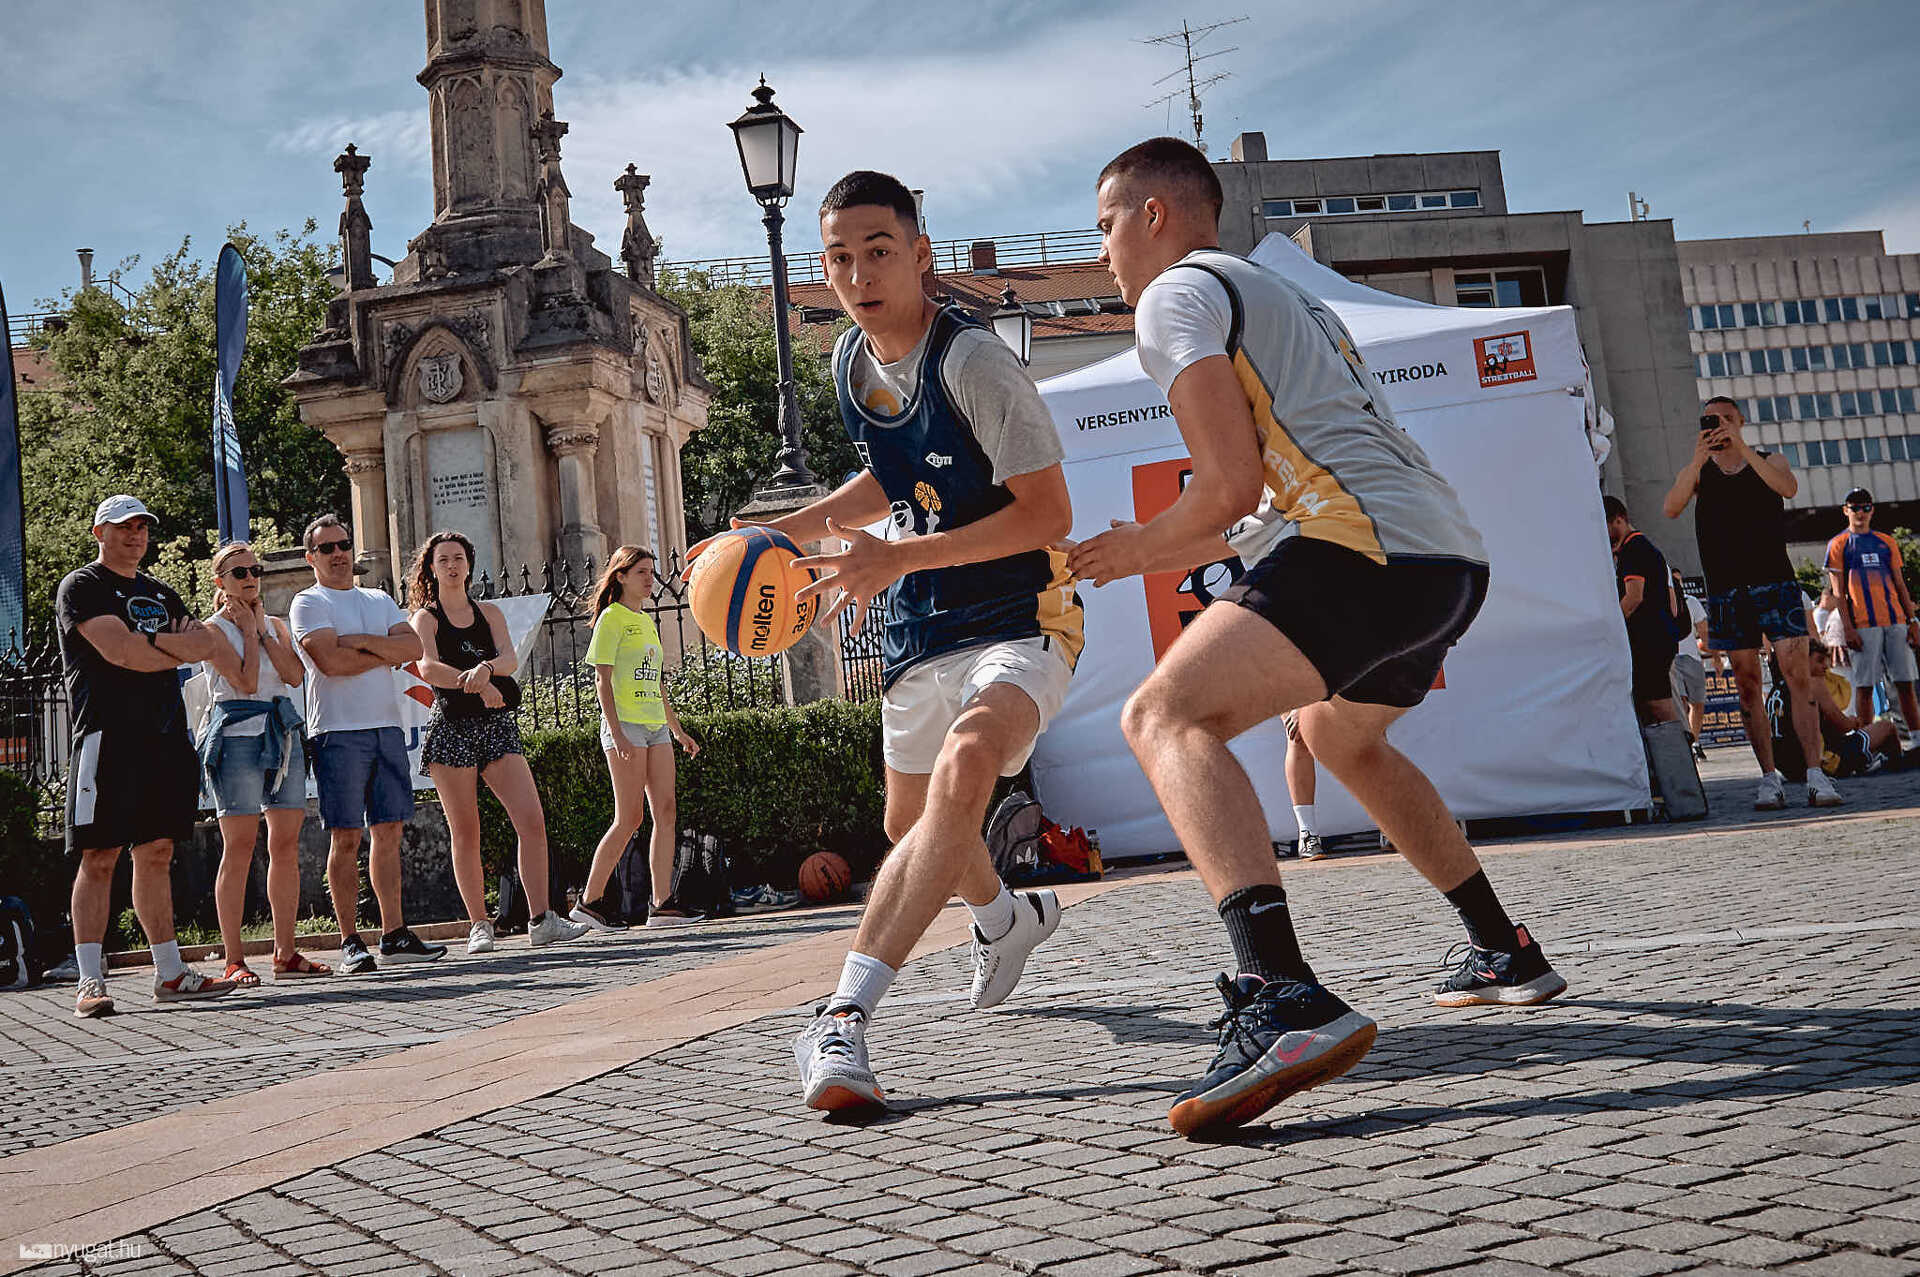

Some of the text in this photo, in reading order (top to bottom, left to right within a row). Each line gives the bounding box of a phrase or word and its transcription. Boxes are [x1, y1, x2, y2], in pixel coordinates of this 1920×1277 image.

[1481, 369, 1536, 385] STREETBALL
[750, 584, 776, 651] molten
[791, 601, 808, 634] 3x3
